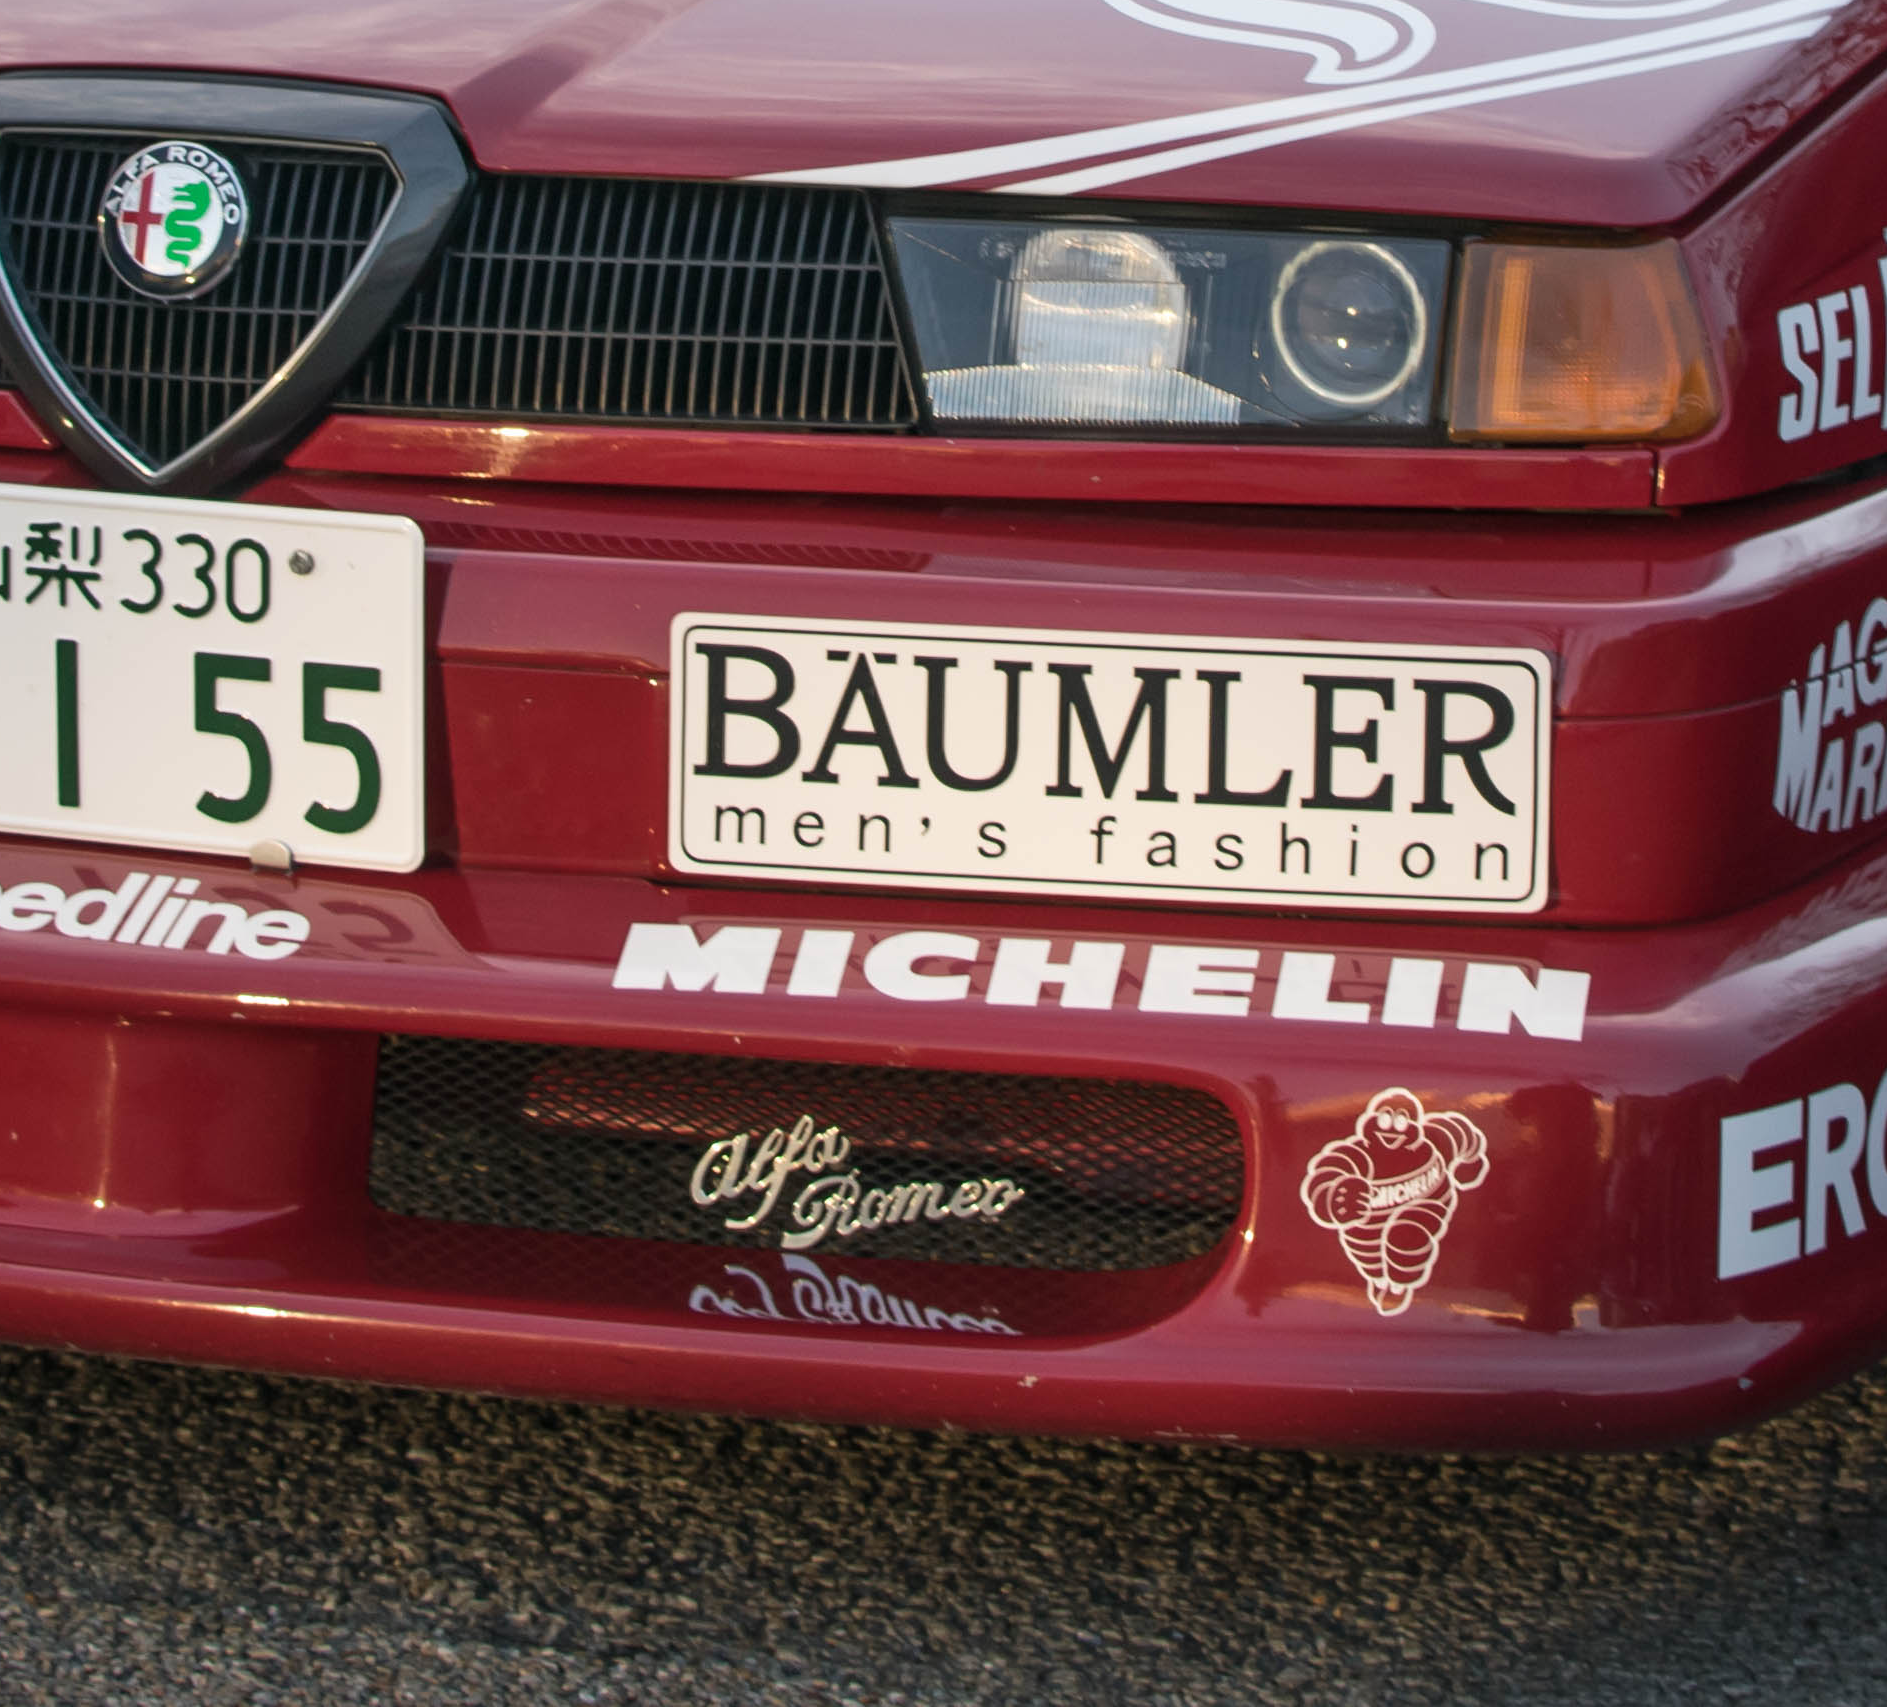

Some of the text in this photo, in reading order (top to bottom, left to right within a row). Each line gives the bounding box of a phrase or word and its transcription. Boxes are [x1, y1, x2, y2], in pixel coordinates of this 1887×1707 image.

[105, 145, 241, 226] ALFA ROMEO
[693, 642, 1517, 817] BÄUMLER
[713, 803, 1511, 882] men's fashion
[611, 921, 1592, 1042] MICHELIN
[690, 1114, 851, 1230] Alfa
[780, 1168, 1026, 1250] Romeo
